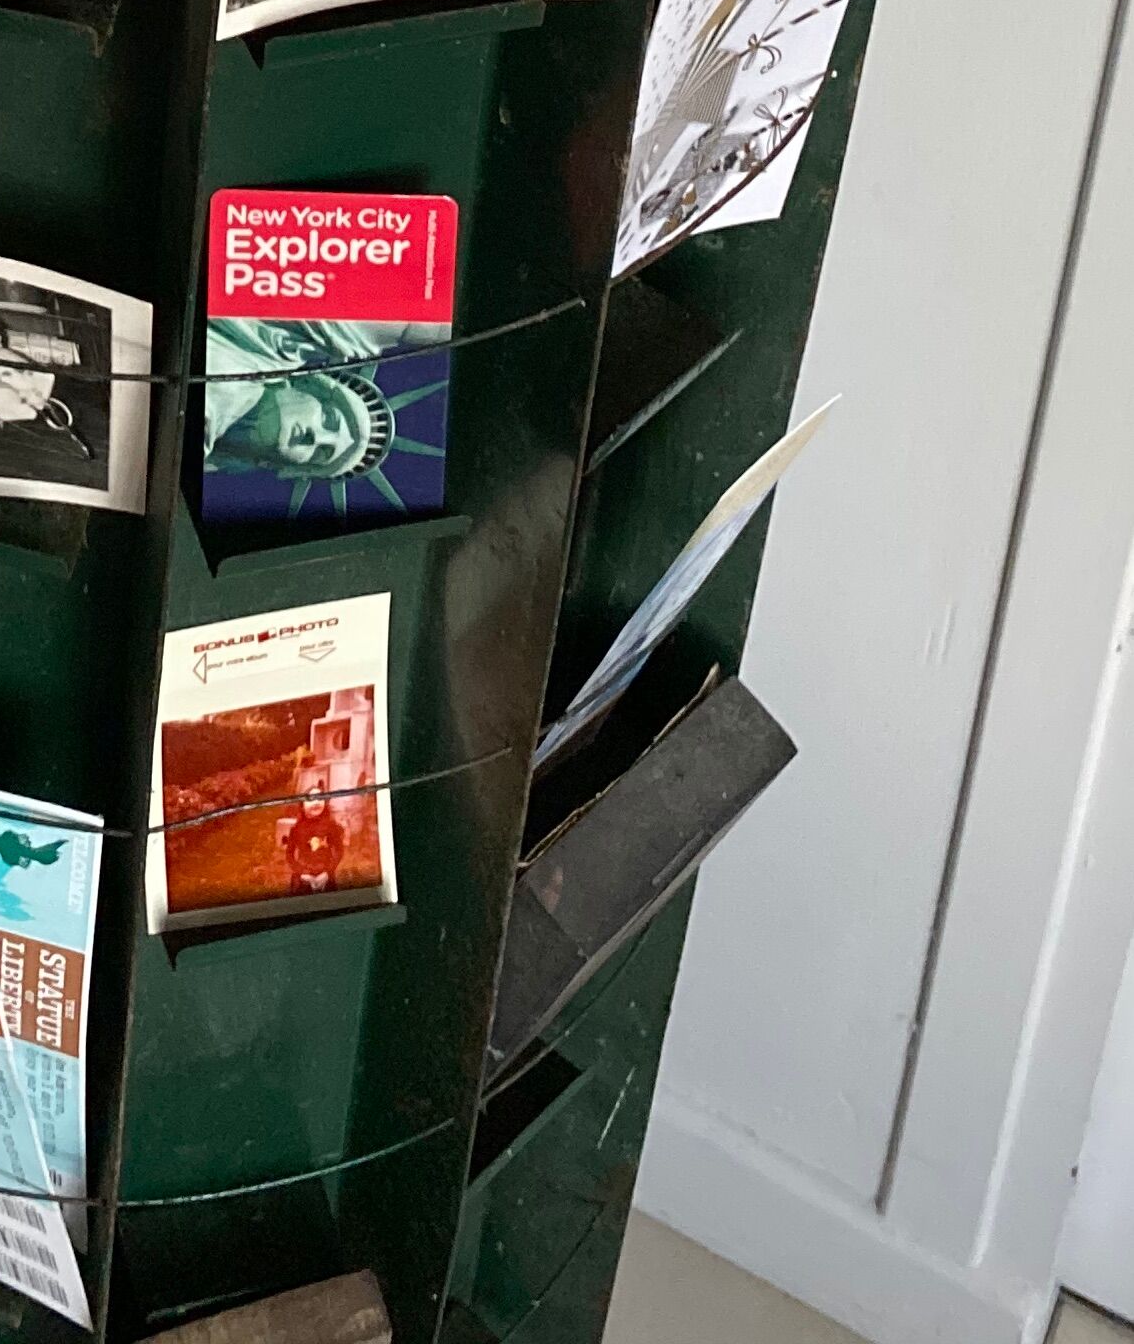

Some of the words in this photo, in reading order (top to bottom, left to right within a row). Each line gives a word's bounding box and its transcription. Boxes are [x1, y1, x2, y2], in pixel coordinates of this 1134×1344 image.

[227, 203, 287, 226] New
[291, 205, 352, 228] York
[357, 207, 411, 234] City
[225, 227, 411, 269] Explorer
[224, 261, 326, 298] Pass
[193, 633, 255, 654] BONUS
[279, 617, 339, 636] PHOTO
[35, 948, 66, 1049] STATUE
